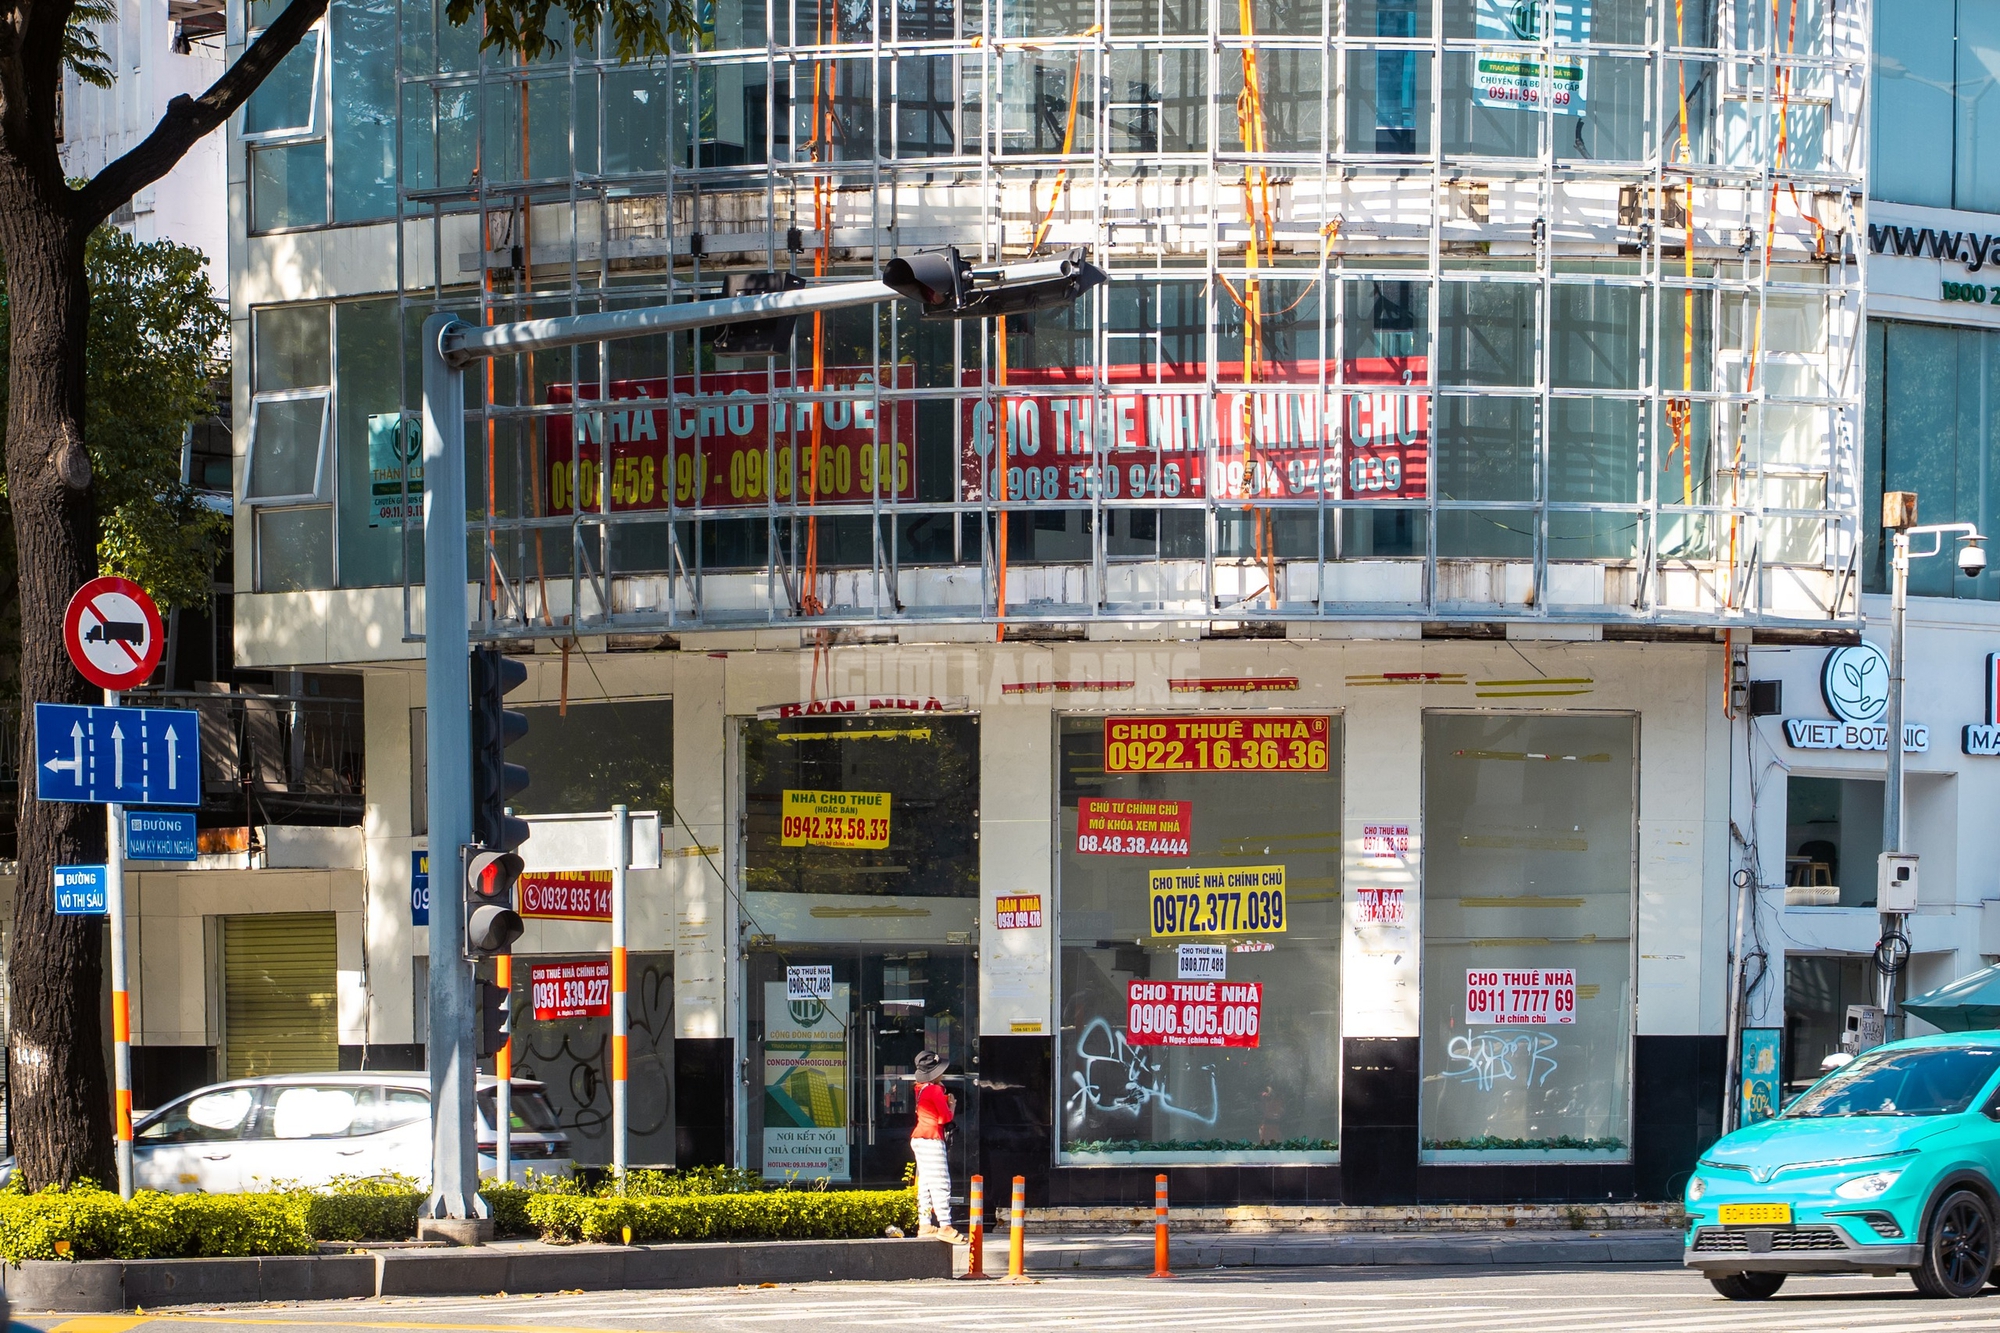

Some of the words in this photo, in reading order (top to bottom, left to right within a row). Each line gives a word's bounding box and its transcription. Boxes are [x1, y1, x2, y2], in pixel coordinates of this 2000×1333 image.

[1480, 75, 1513, 86] CHUYÊN
[1514, 79, 1528, 88] GIA
[1529, 80, 1540, 89] BĐ
[1564, 81, 1580, 92] CẤP
[1942, 281, 1987, 303] 1900
[578, 386, 657, 445] NHÀ
[672, 388, 755, 439] CHO
[774, 373, 875, 432] THUÊ
[972, 399, 1041, 458] CHO
[1350, 369, 1419, 448] CHỦ
[373, 466, 401, 481] THÀN
[611, 455, 655, 505] 458
[661, 453, 708, 502] 999
[713, 475, 723, 484] -
[730, 447, 793, 499] 0908
[802, 444, 851, 495] 560
[859, 442, 908, 494] 946
[1129, 463, 1181, 498] 946
[1350, 456, 1402, 493] 039
[1112, 723, 1167, 740] CHO
[1176, 720, 1244, 739] THUÊ
[1252, 720, 1311, 738] NHÀ
[1792, 724, 1839, 744] VIET
[1108, 740, 1326, 770] 0922.16.36.36
[791, 791, 816, 803] NHÀ
[820, 794, 847, 805] CHO
[850, 793, 882, 806] THUÊ
[1089, 800, 1110, 813] CHÚ
[1111, 802, 1126, 814] TƯ
[1126, 801, 1157, 815] CHÍNH
[1158, 801, 1179, 816] CHỦ
[814, 806, 838, 816] (HOẶC
[840, 806, 858, 816] BÁN)
[142, 817, 182, 832] ĐƯỜNG
[783, 815, 889, 841] 0942.33.58.33
[1089, 816, 1106, 830] MỞ
[1107, 818, 1134, 831] KHÓA
[1135, 820, 1158, 832] XEM
[1159, 819, 1181, 833] NHÀ
[1364, 826, 1378, 835] CHO
[1379, 825, 1395, 836] THUÊ
[130, 840, 146, 854] NAM
[146, 836, 156, 854] KỲ
[157, 835, 173, 854] KHỞI
[173, 837, 194, 855] NGHĨA
[1078, 835, 1189, 855] 08.48.38.4444
[66, 871, 97, 885] ĐƯỜNG
[1152, 877, 1173, 890] CHO
[1175, 873, 1201, 889] THUÊ
[1203, 872, 1225, 888] NHÀ
[1227, 871, 1259, 887] CHÍNH
[1262, 868, 1283, 886] CHỦ
[60, 890, 71, 908] VÕ
[72, 893, 86, 911] THỊ
[86, 889, 103, 908] SÁU
[541, 886, 568, 910] 0932
[570, 887, 591, 912] 935
[997, 897, 1017, 913] BÁN
[1019, 896, 1040, 912] NHÀ
[1153, 890, 1283, 934] 0972.377.039
[1181, 947, 1194, 955] CHO
[1195, 946, 1210, 955] THUÊ
[532, 969, 545, 980] CHO
[546, 966, 562, 980] THUÊ
[562, 965, 576, 979] NHÀ
[576, 964, 596, 978] CHÍNH
[596, 962, 609, 977] CHỦ
[788, 968, 801, 976] CHO
[802, 966, 817, 975] THUÊ
[817, 966, 831, 975] NHÀ
[1468, 972, 1498, 986] CHO
[1502, 969, 1540, 986] THUÊ
[1544, 969, 1574, 986] NHÀ
[533, 979, 609, 1009] 0931.339.227
[1130, 983, 1167, 1001] CHO
[1171, 982, 1216, 1002] THUÊ
[1221, 983, 1259, 1003] NHÀ
[1468, 988, 1505, 1012] 0911
[1511, 989, 1550, 1012] 7777
[1555, 988, 1574, 1012] 69
[1130, 1003, 1258, 1036] 0906.905.006
[1495, 1014, 1505, 1023] LH
[1507, 1013, 1530, 1023] chính
[1531, 1013, 1547, 1023] chủ
[770, 1030, 790, 1040] CỘNG
[791, 1029, 812, 1039] ĐỒNG
[813, 1030, 828, 1039] MÔI
[1162, 1035, 1168, 1043] A
[1168, 1035, 1186, 1045] Ngọc
[1187, 1036, 1209, 1045] (chính
[776, 1132, 794, 1141] NƠI
[797, 1129, 816, 1141] KẾT
[818, 1129, 836, 1141] NỐI
[767, 1144, 789, 1154] NHÀ
[791, 1144, 822, 1155] CHÍNH
[824, 1144, 845, 1155] CHỦ
